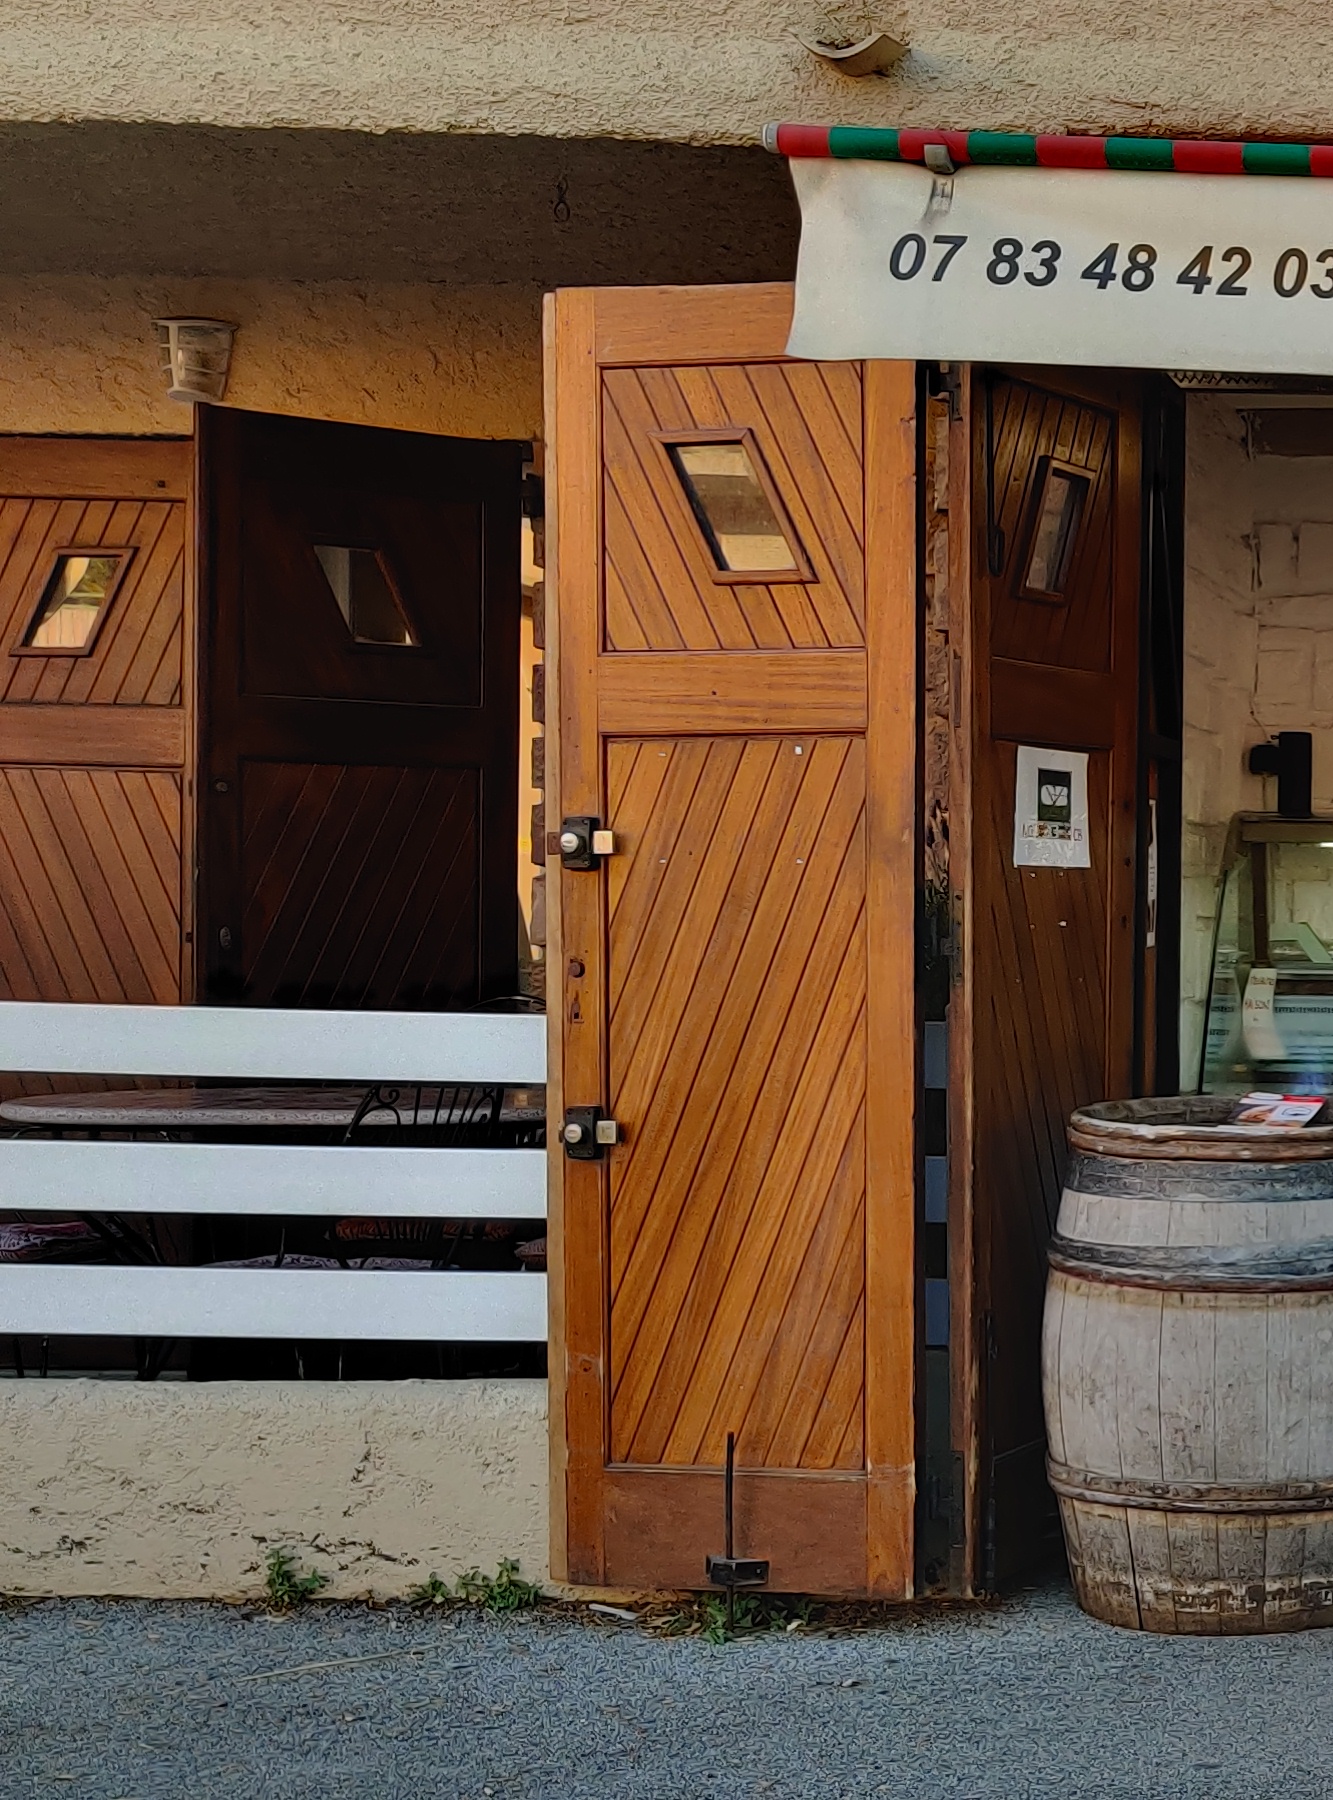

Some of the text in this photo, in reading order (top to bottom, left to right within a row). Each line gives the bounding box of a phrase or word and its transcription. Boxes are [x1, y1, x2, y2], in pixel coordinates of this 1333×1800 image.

[889, 233, 967, 282] 07
[986, 237, 1062, 287] 83
[1080, 242, 1158, 292] 48
[1175, 245, 1252, 296] 42
